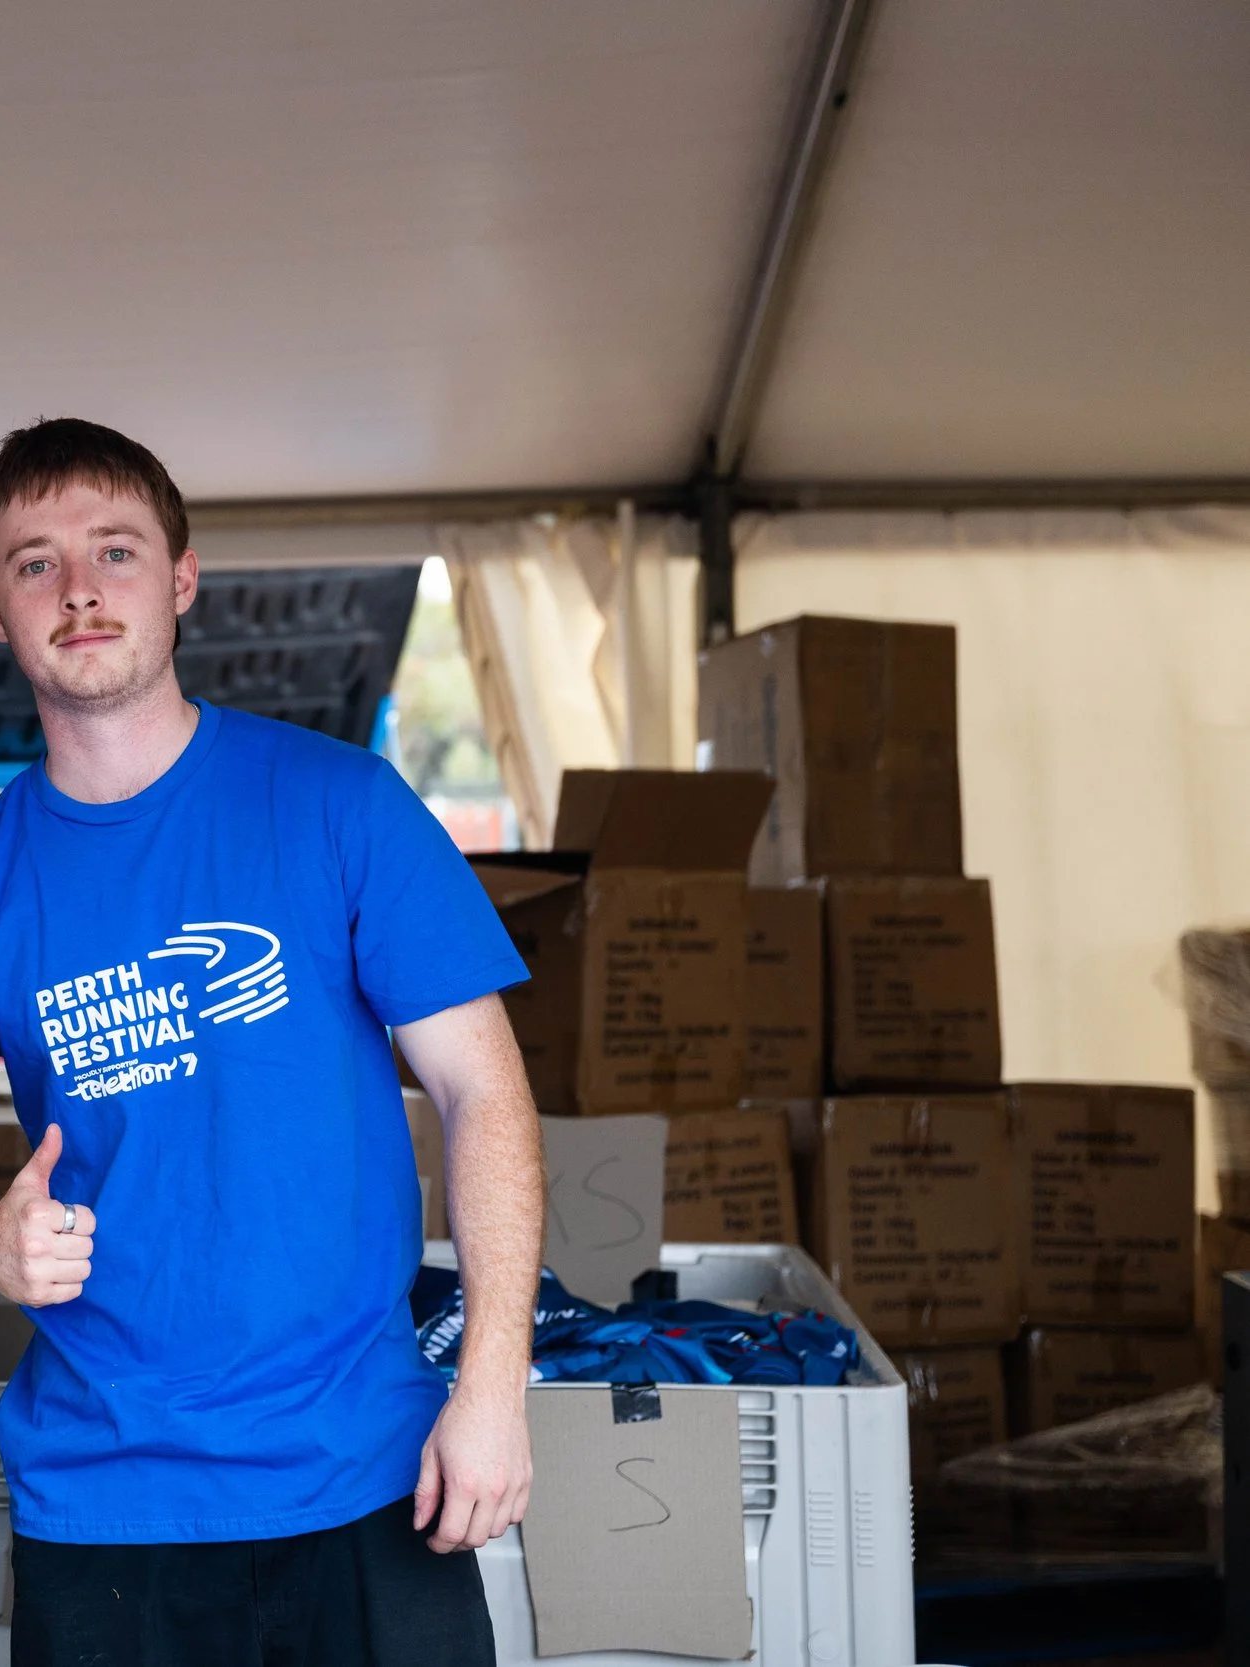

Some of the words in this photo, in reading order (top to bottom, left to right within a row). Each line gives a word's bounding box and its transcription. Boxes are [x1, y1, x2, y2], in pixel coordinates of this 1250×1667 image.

[35, 961, 143, 1018] PERTH
[41, 982, 189, 1047] RUNNING
[49, 1014, 195, 1076] FESTIVAL
[74, 1067, 102, 1082] PROUDLY
[102, 1058, 139, 1073] SUPPORTING
[65, 1057, 178, 1102] telethon
[608, 1457, 671, 1532] S
